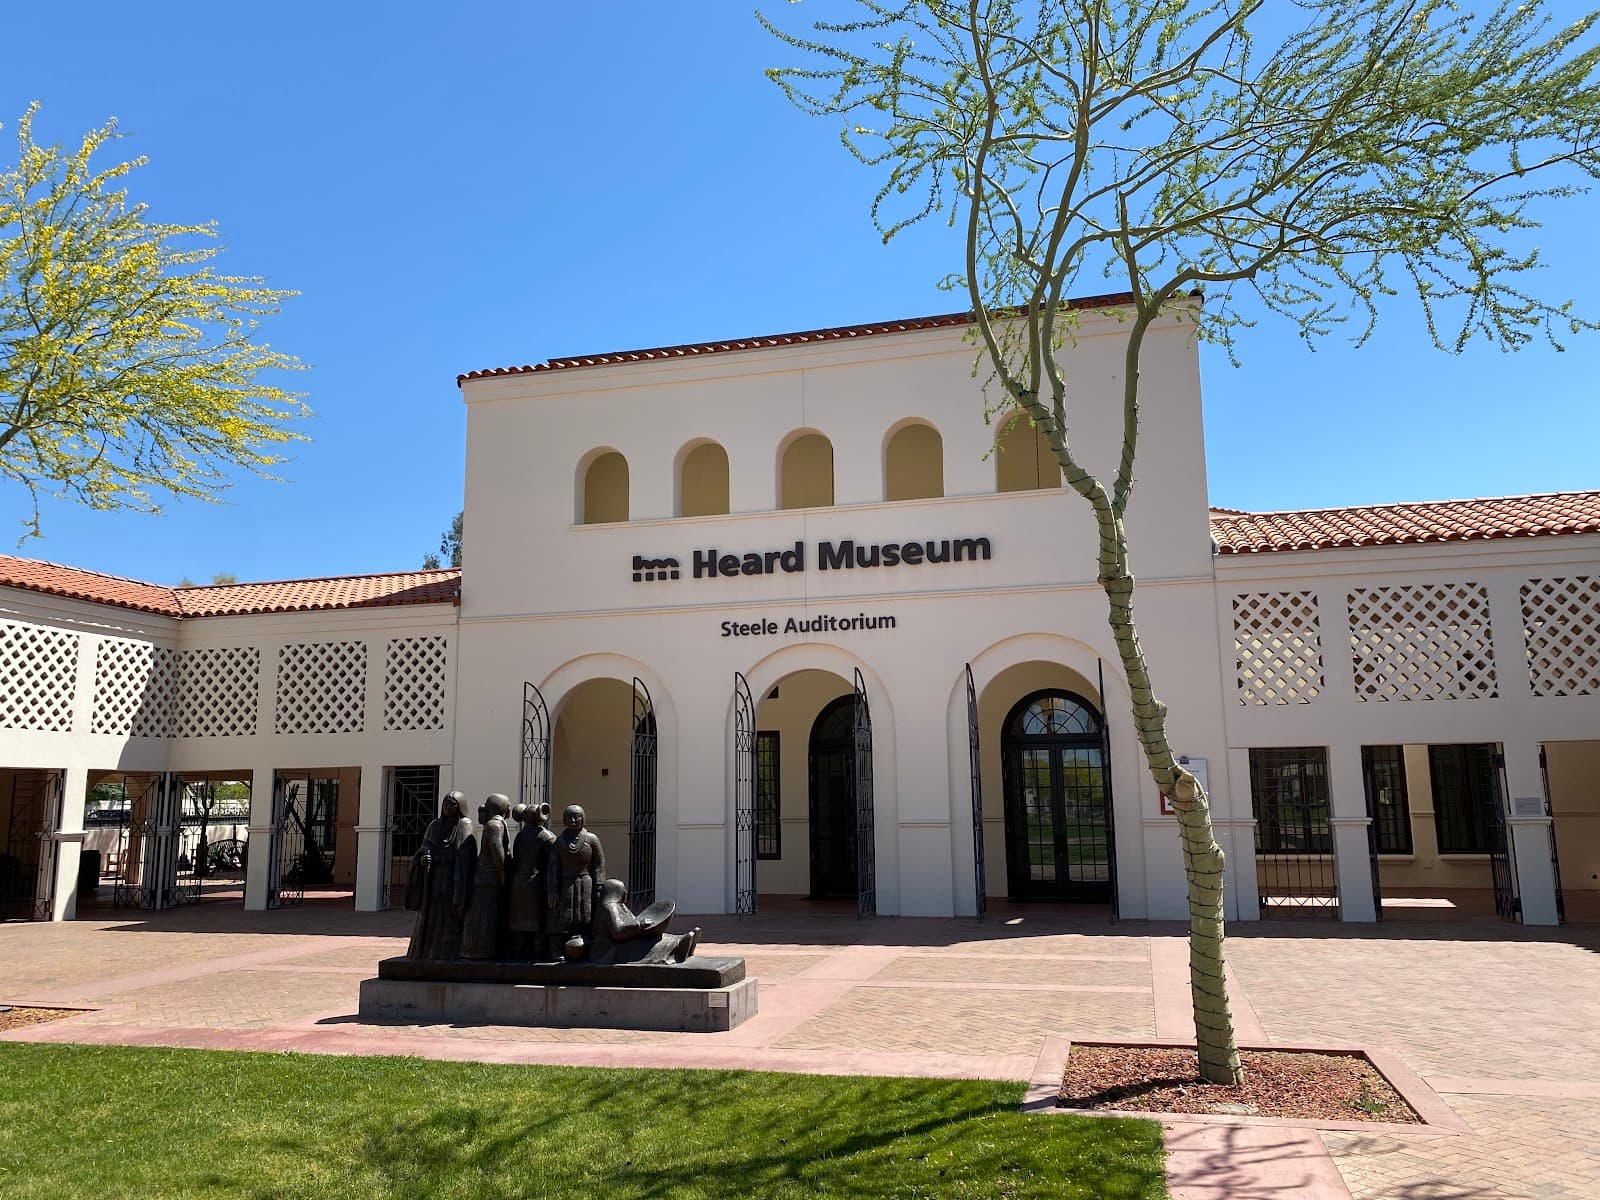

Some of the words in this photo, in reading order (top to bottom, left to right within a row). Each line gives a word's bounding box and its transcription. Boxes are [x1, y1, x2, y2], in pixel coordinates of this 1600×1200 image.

[693, 541, 805, 578] Heard
[818, 537, 992, 571] Museum
[721, 618, 778, 637] Steele
[784, 613, 896, 634] Auditorium
